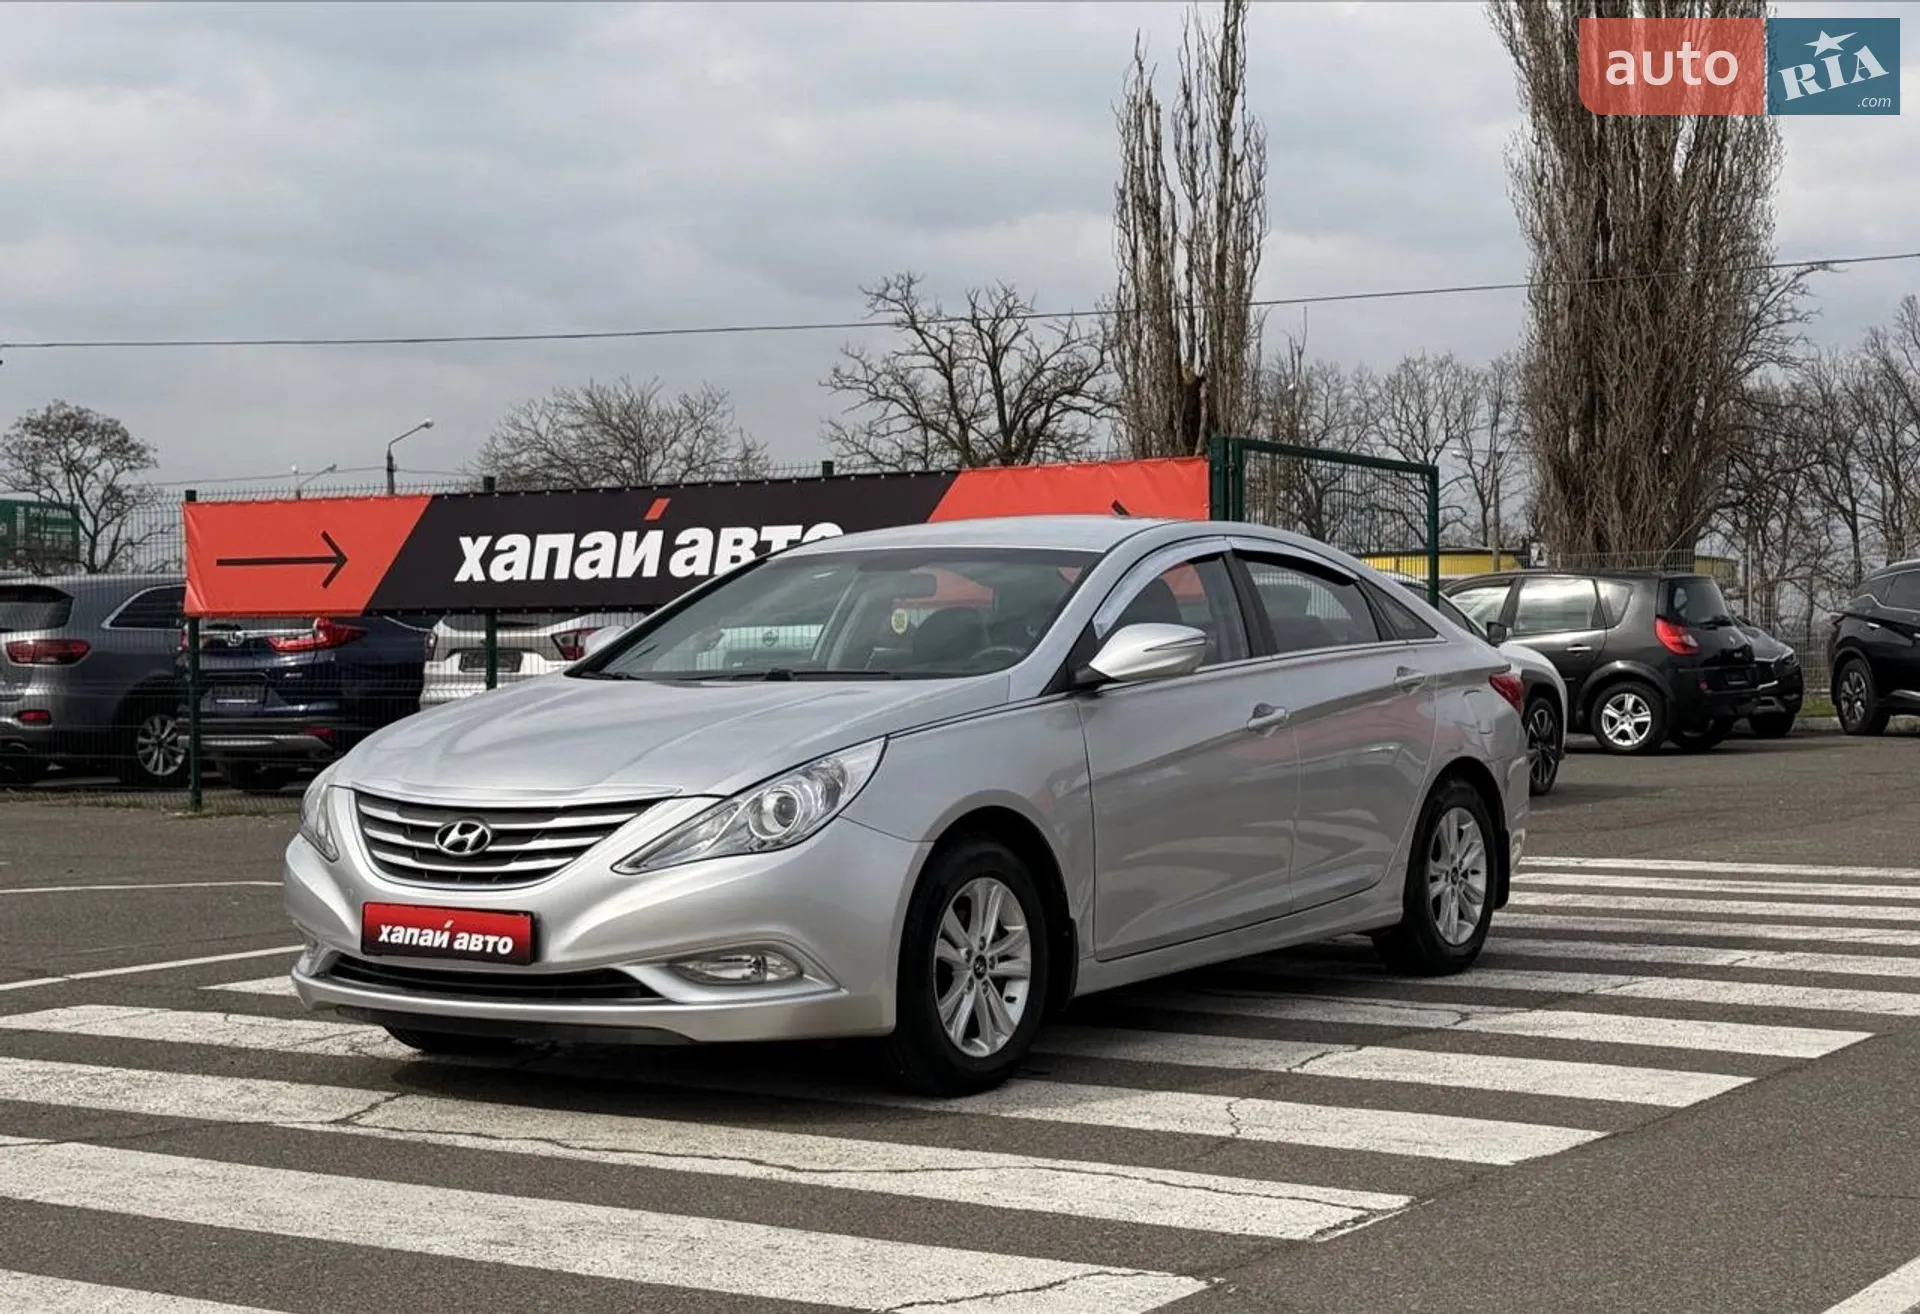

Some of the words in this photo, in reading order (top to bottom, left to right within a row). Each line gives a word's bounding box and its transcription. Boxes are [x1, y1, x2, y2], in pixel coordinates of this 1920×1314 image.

[453, 498, 672, 582] хапай
[378, 920, 454, 949] хапай
[453, 931, 513, 955] авто
